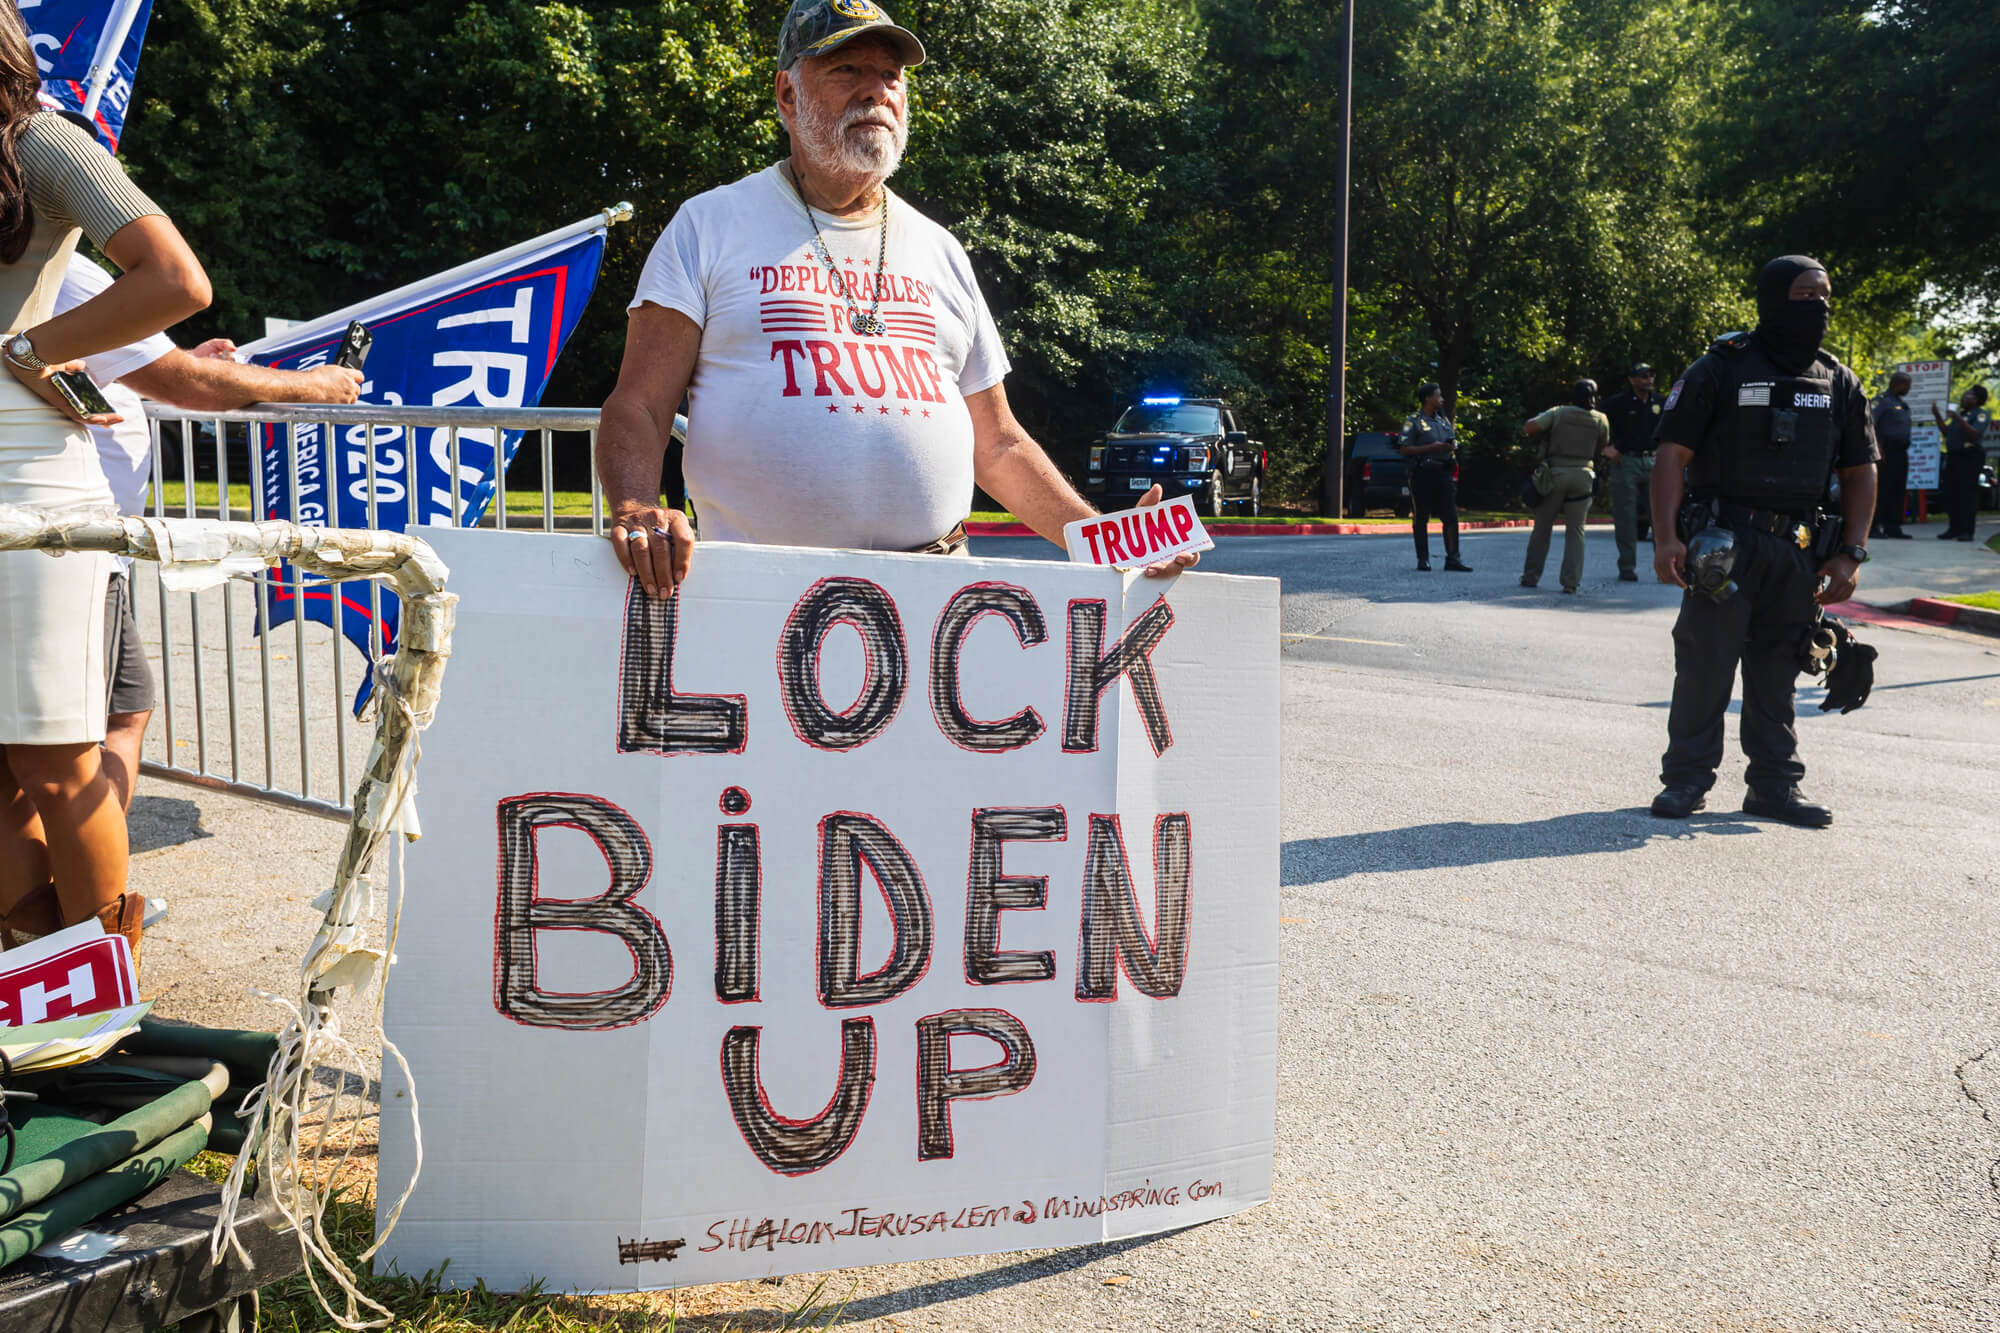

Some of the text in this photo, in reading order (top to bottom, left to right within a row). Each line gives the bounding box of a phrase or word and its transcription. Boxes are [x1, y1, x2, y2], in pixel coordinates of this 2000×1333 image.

[770, 339, 947, 404] TRUMP
[1905, 362, 1944, 373] STOP!
[1794, 392, 1832, 409] SHERIFF
[1081, 504, 1194, 566] TRUMP
[616, 576, 1175, 758] LOCK
[720, 1008, 1037, 1177] UP
